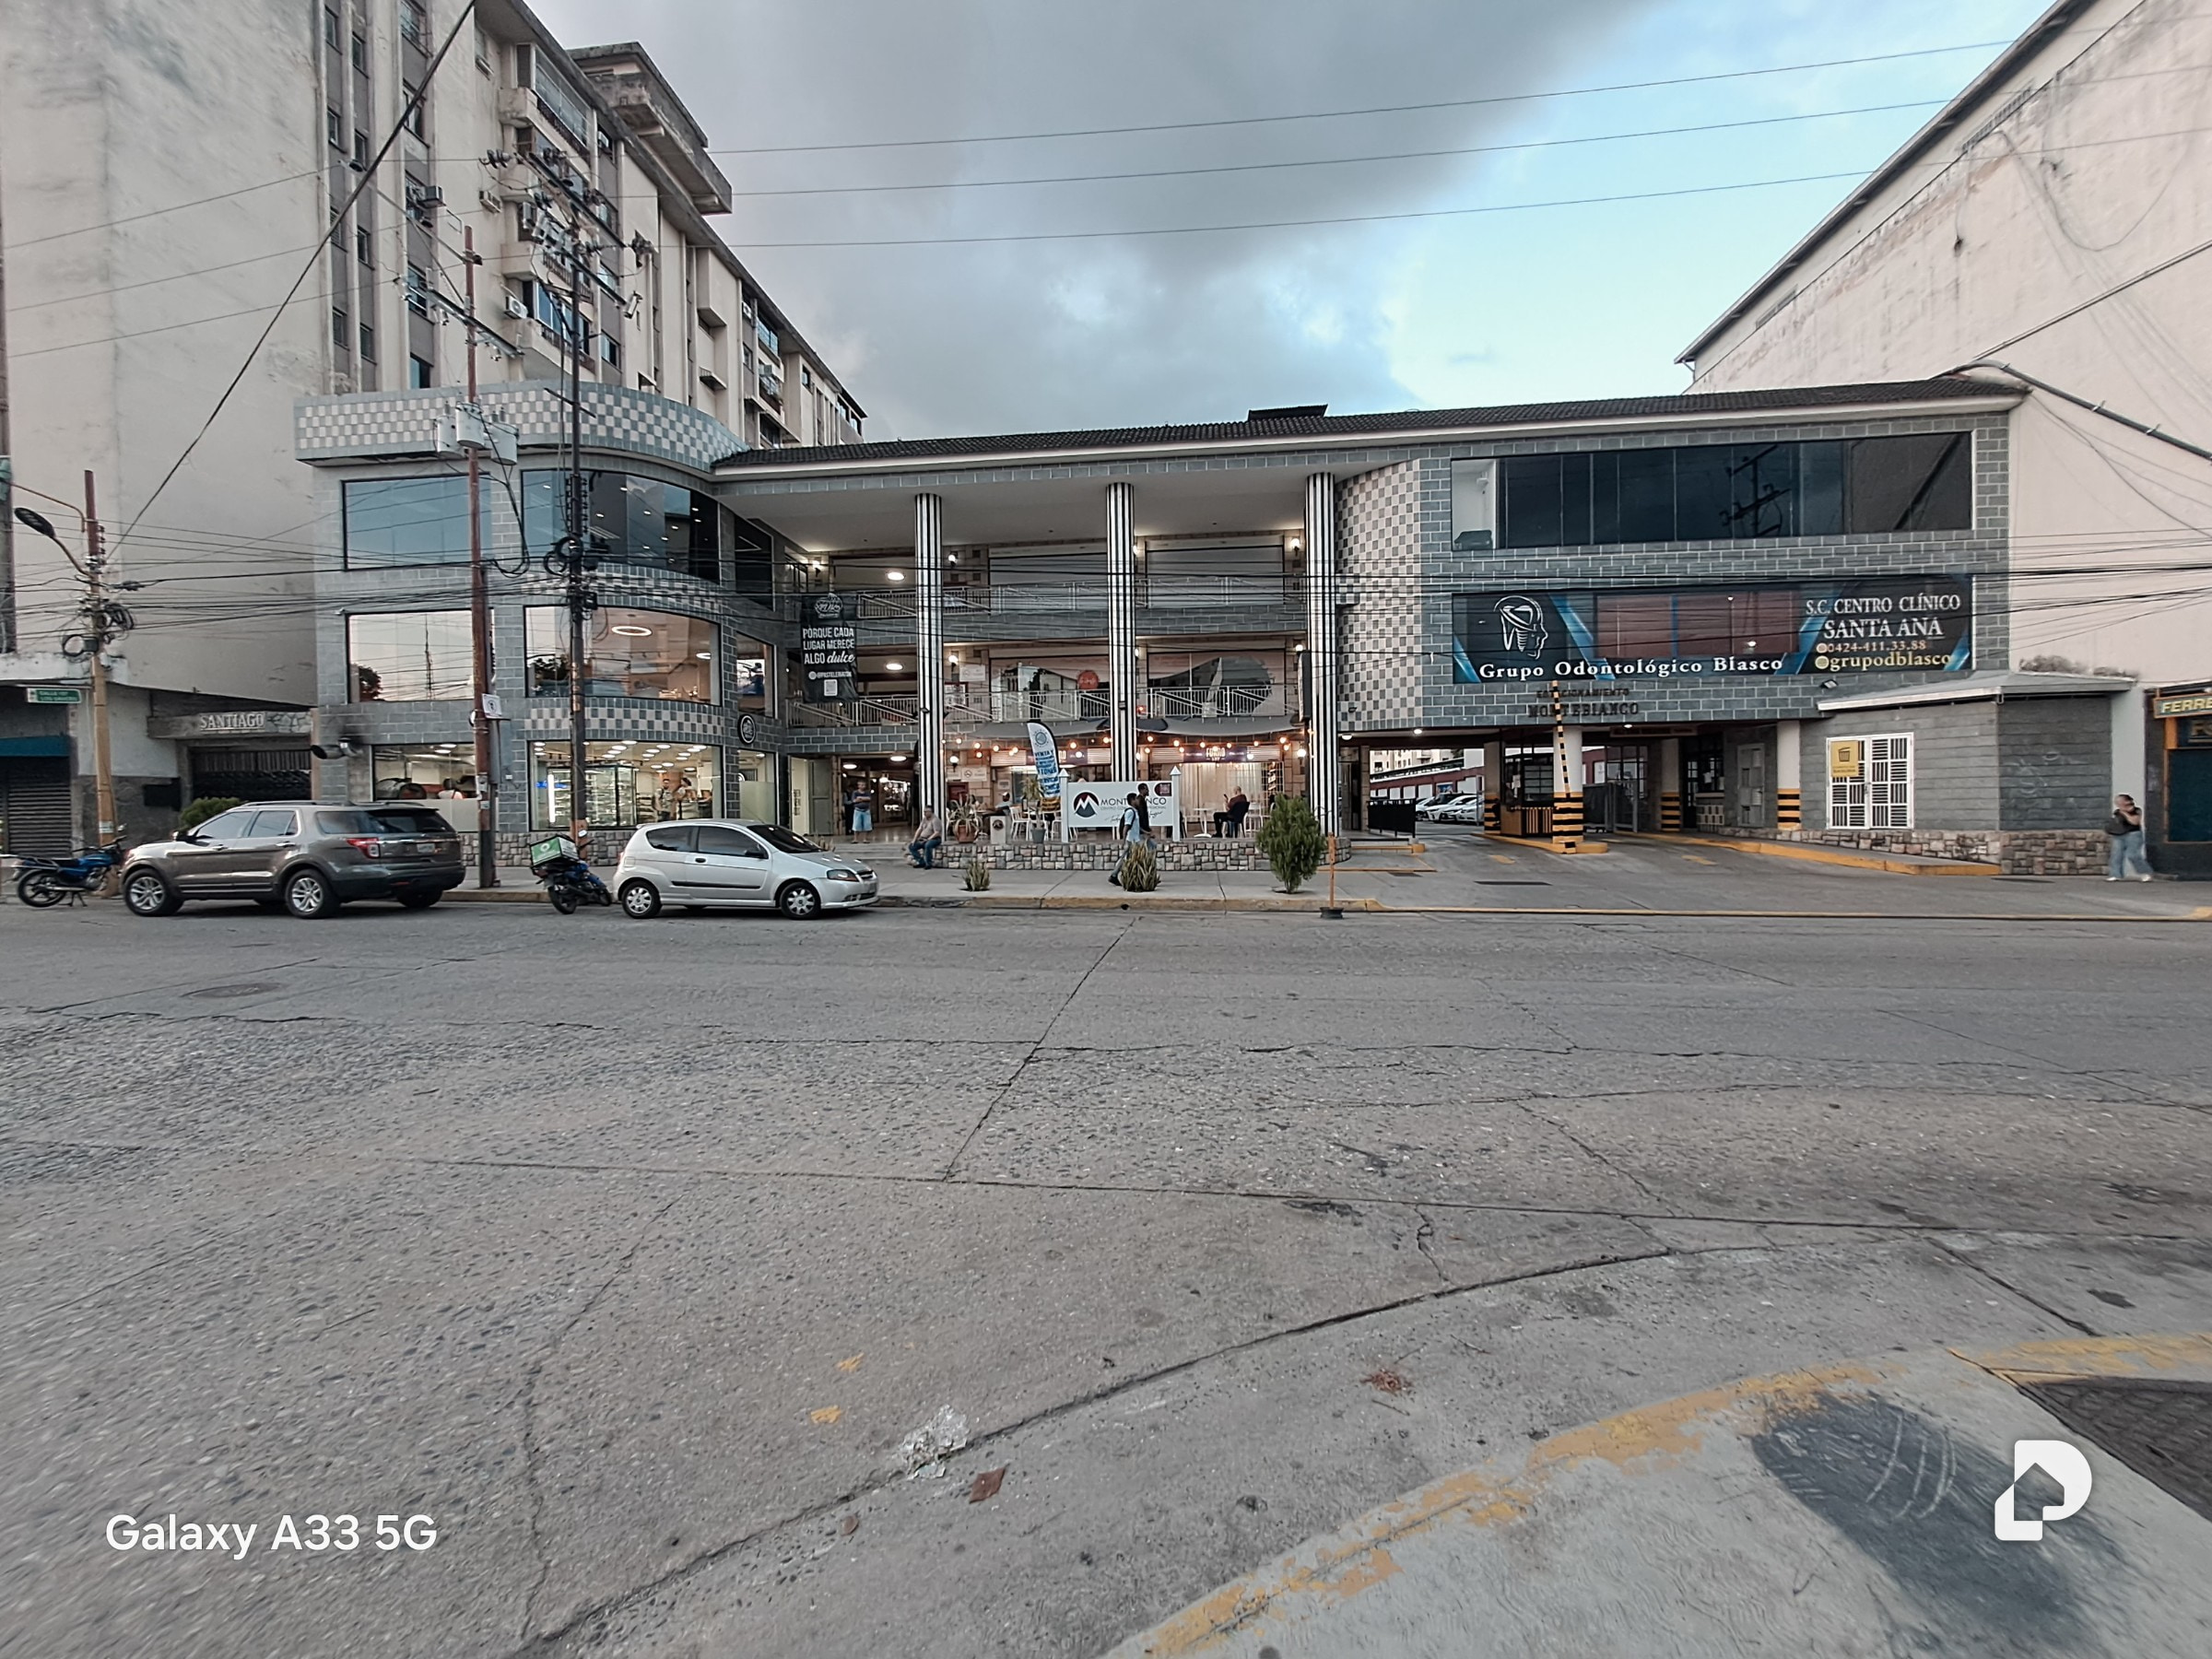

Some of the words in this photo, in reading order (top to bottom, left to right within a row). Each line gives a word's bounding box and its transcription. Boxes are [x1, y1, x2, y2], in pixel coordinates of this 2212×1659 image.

[1806, 599, 1830, 616] S.C.
[1833, 596, 1892, 615] CENTRO
[1899, 592, 1961, 612] CLÍNICO
[803, 628, 832, 639] PORQUE
[833, 627, 854, 639] CADA
[1823, 618, 1892, 640] SANTA
[1897, 617, 1944, 637] ANA
[803, 640, 826, 651] LUGAR
[827, 639, 855, 649] MERECE
[1826, 640, 1927, 653] 0424-411.33.88
[804, 653, 826, 665] ALGO
[827, 651, 855, 664] dulce
[1829, 652, 1952, 672] grupodblasco
[1479, 663, 1545, 681] Grupo
[1554, 658, 1703, 677] Odontológico
[1713, 656, 1783, 672] Blasco
[200, 712, 265, 729] SANTIAGO
[1100, 796, 1167, 806] MONTNCO
